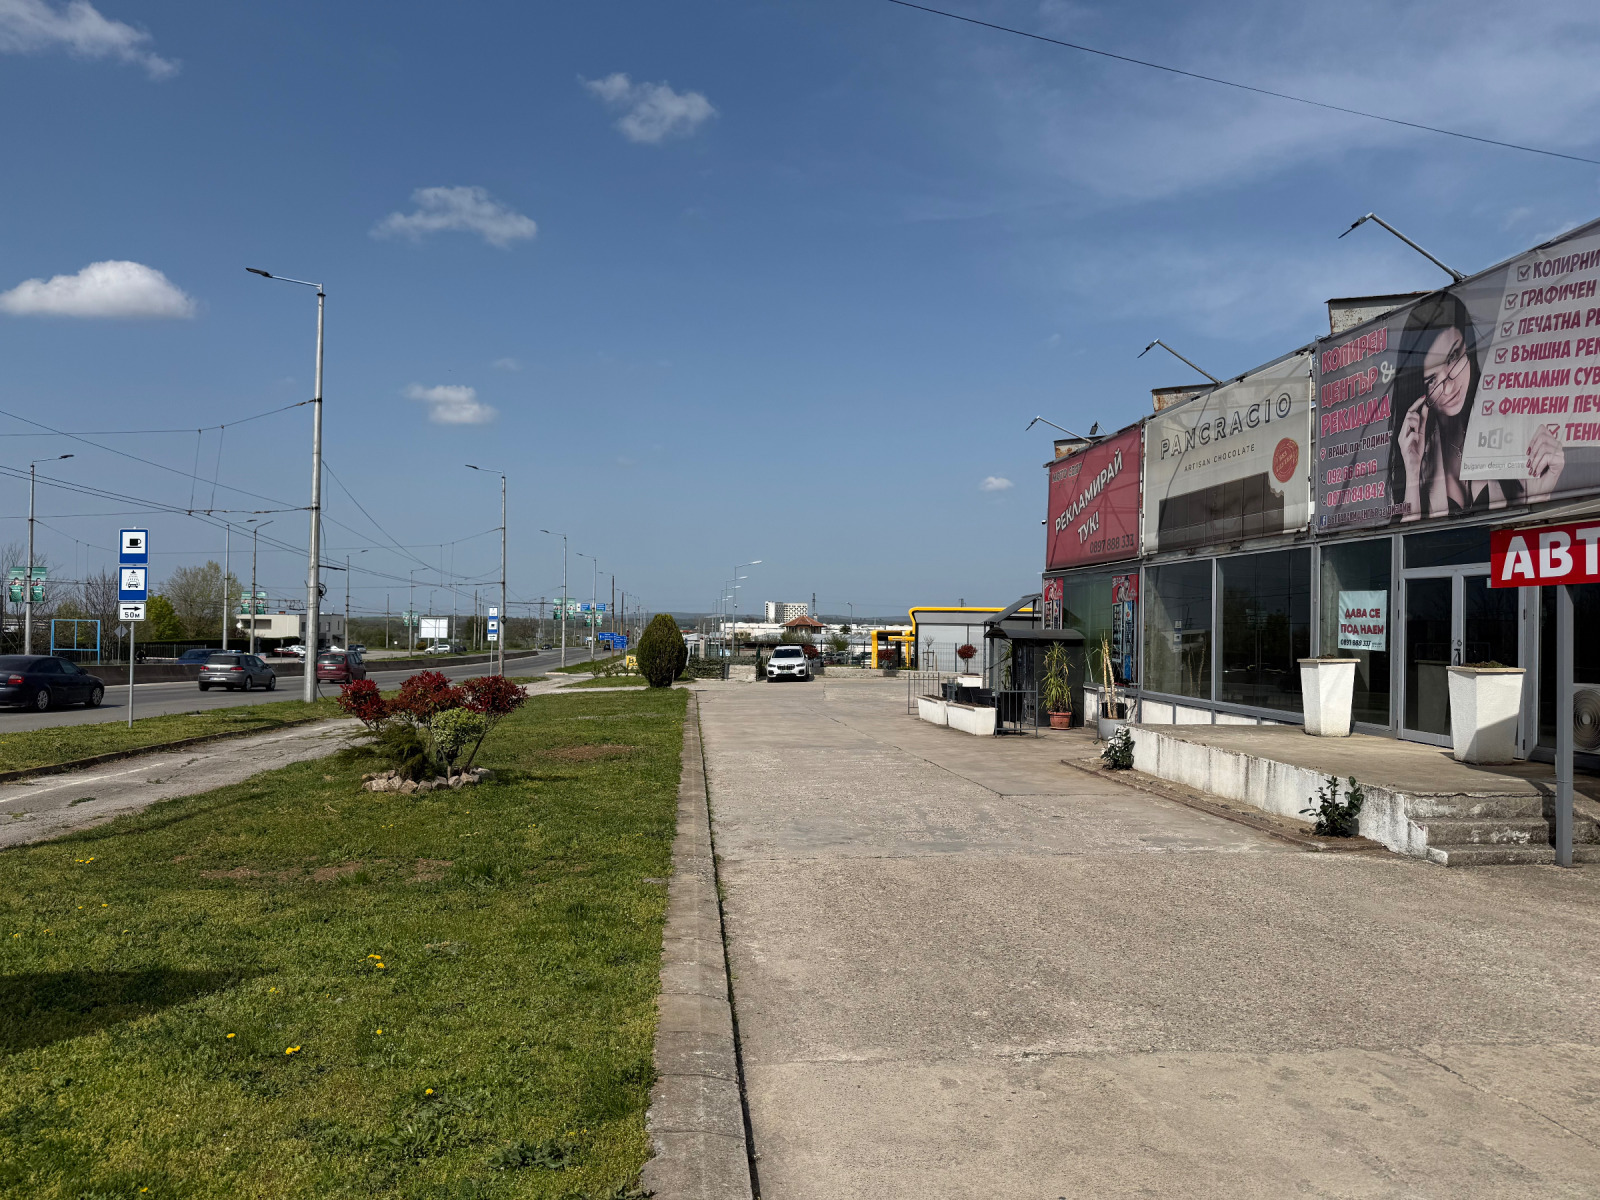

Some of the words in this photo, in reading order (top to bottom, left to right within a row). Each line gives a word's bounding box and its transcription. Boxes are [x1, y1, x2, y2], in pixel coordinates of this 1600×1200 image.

[1533, 249, 1600, 279] КОПИРНИ
[1520, 279, 1597, 308] ГРАФИЧЕН
[1517, 310, 1581, 335] ПЕЧАТНА
[1322, 326, 1388, 375] КОПИРЕН
[1511, 340, 1571, 362] ВЪНШНА
[1321, 366, 1378, 409] ЦЕНТЪР
[1498, 368, 1571, 389] РЕКЛАМНИ
[1321, 393, 1391, 438] РЕКЛАМА
[1498, 396, 1569, 416] ФИРМЕНИ
[1160, 392, 1292, 460] PANCRACIO
[1184, 458, 1211, 472] ARTISAN
[1213, 443, 1255, 463] CHOCOLATE
[1327, 468, 1342, 485] 092
[1367, 458, 1377, 476] 16
[1055, 448, 1123, 535] РЕКЛАМИРАЙ
[1078, 511, 1099, 544] ТУК!
[1090, 539, 1105, 553] 0897
[1121, 534, 1135, 548] 333
[1345, 608, 1367, 619] ДАВА
[1369, 608, 1380, 618] СЕ
[1340, 624, 1359, 635] ПОД
[1360, 624, 1384, 635] НАЕМ
